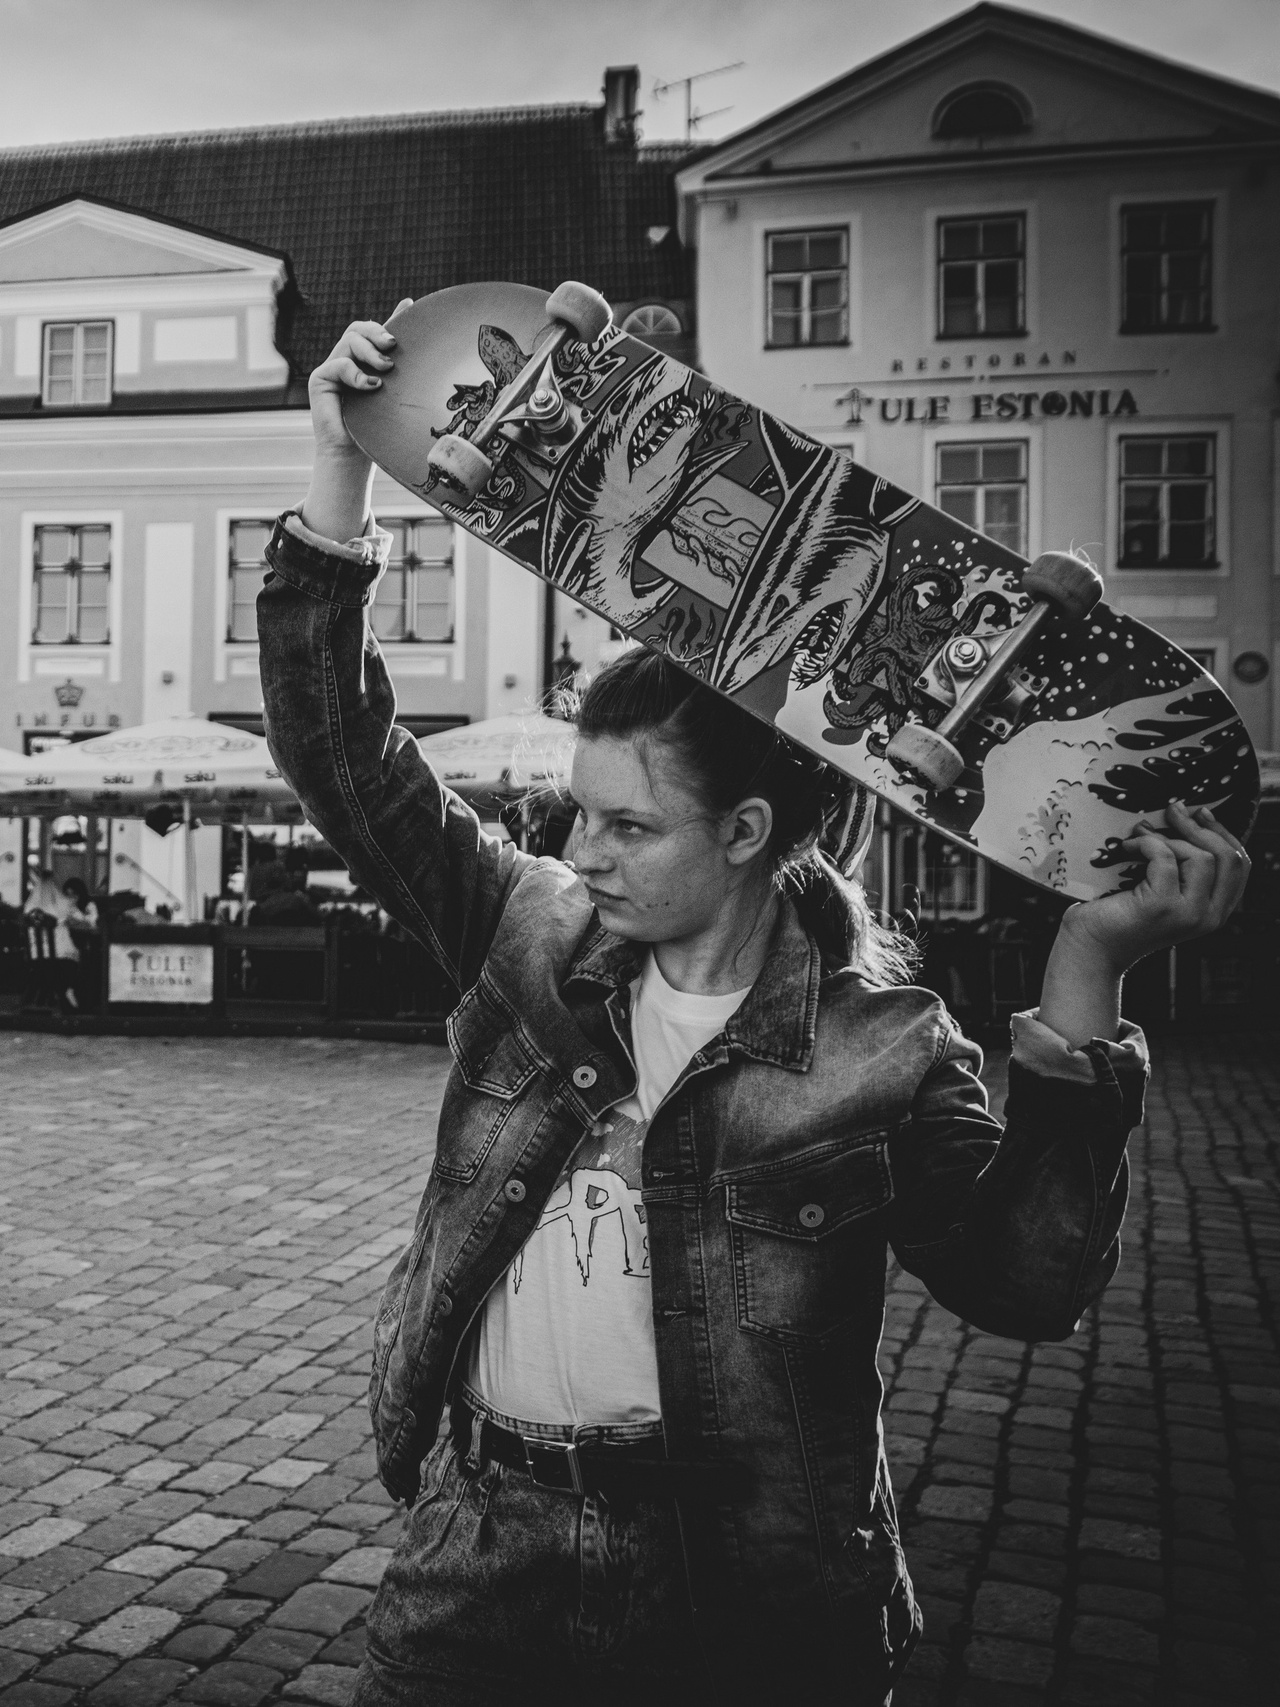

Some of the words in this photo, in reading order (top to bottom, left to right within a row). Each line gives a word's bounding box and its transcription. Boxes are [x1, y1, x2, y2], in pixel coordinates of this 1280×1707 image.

[891, 350, 1076, 373] RESTORAN
[834, 388, 951, 423] TULE
[972, 388, 1139, 420] ESTONIA
[184, 770, 216, 783] saku
